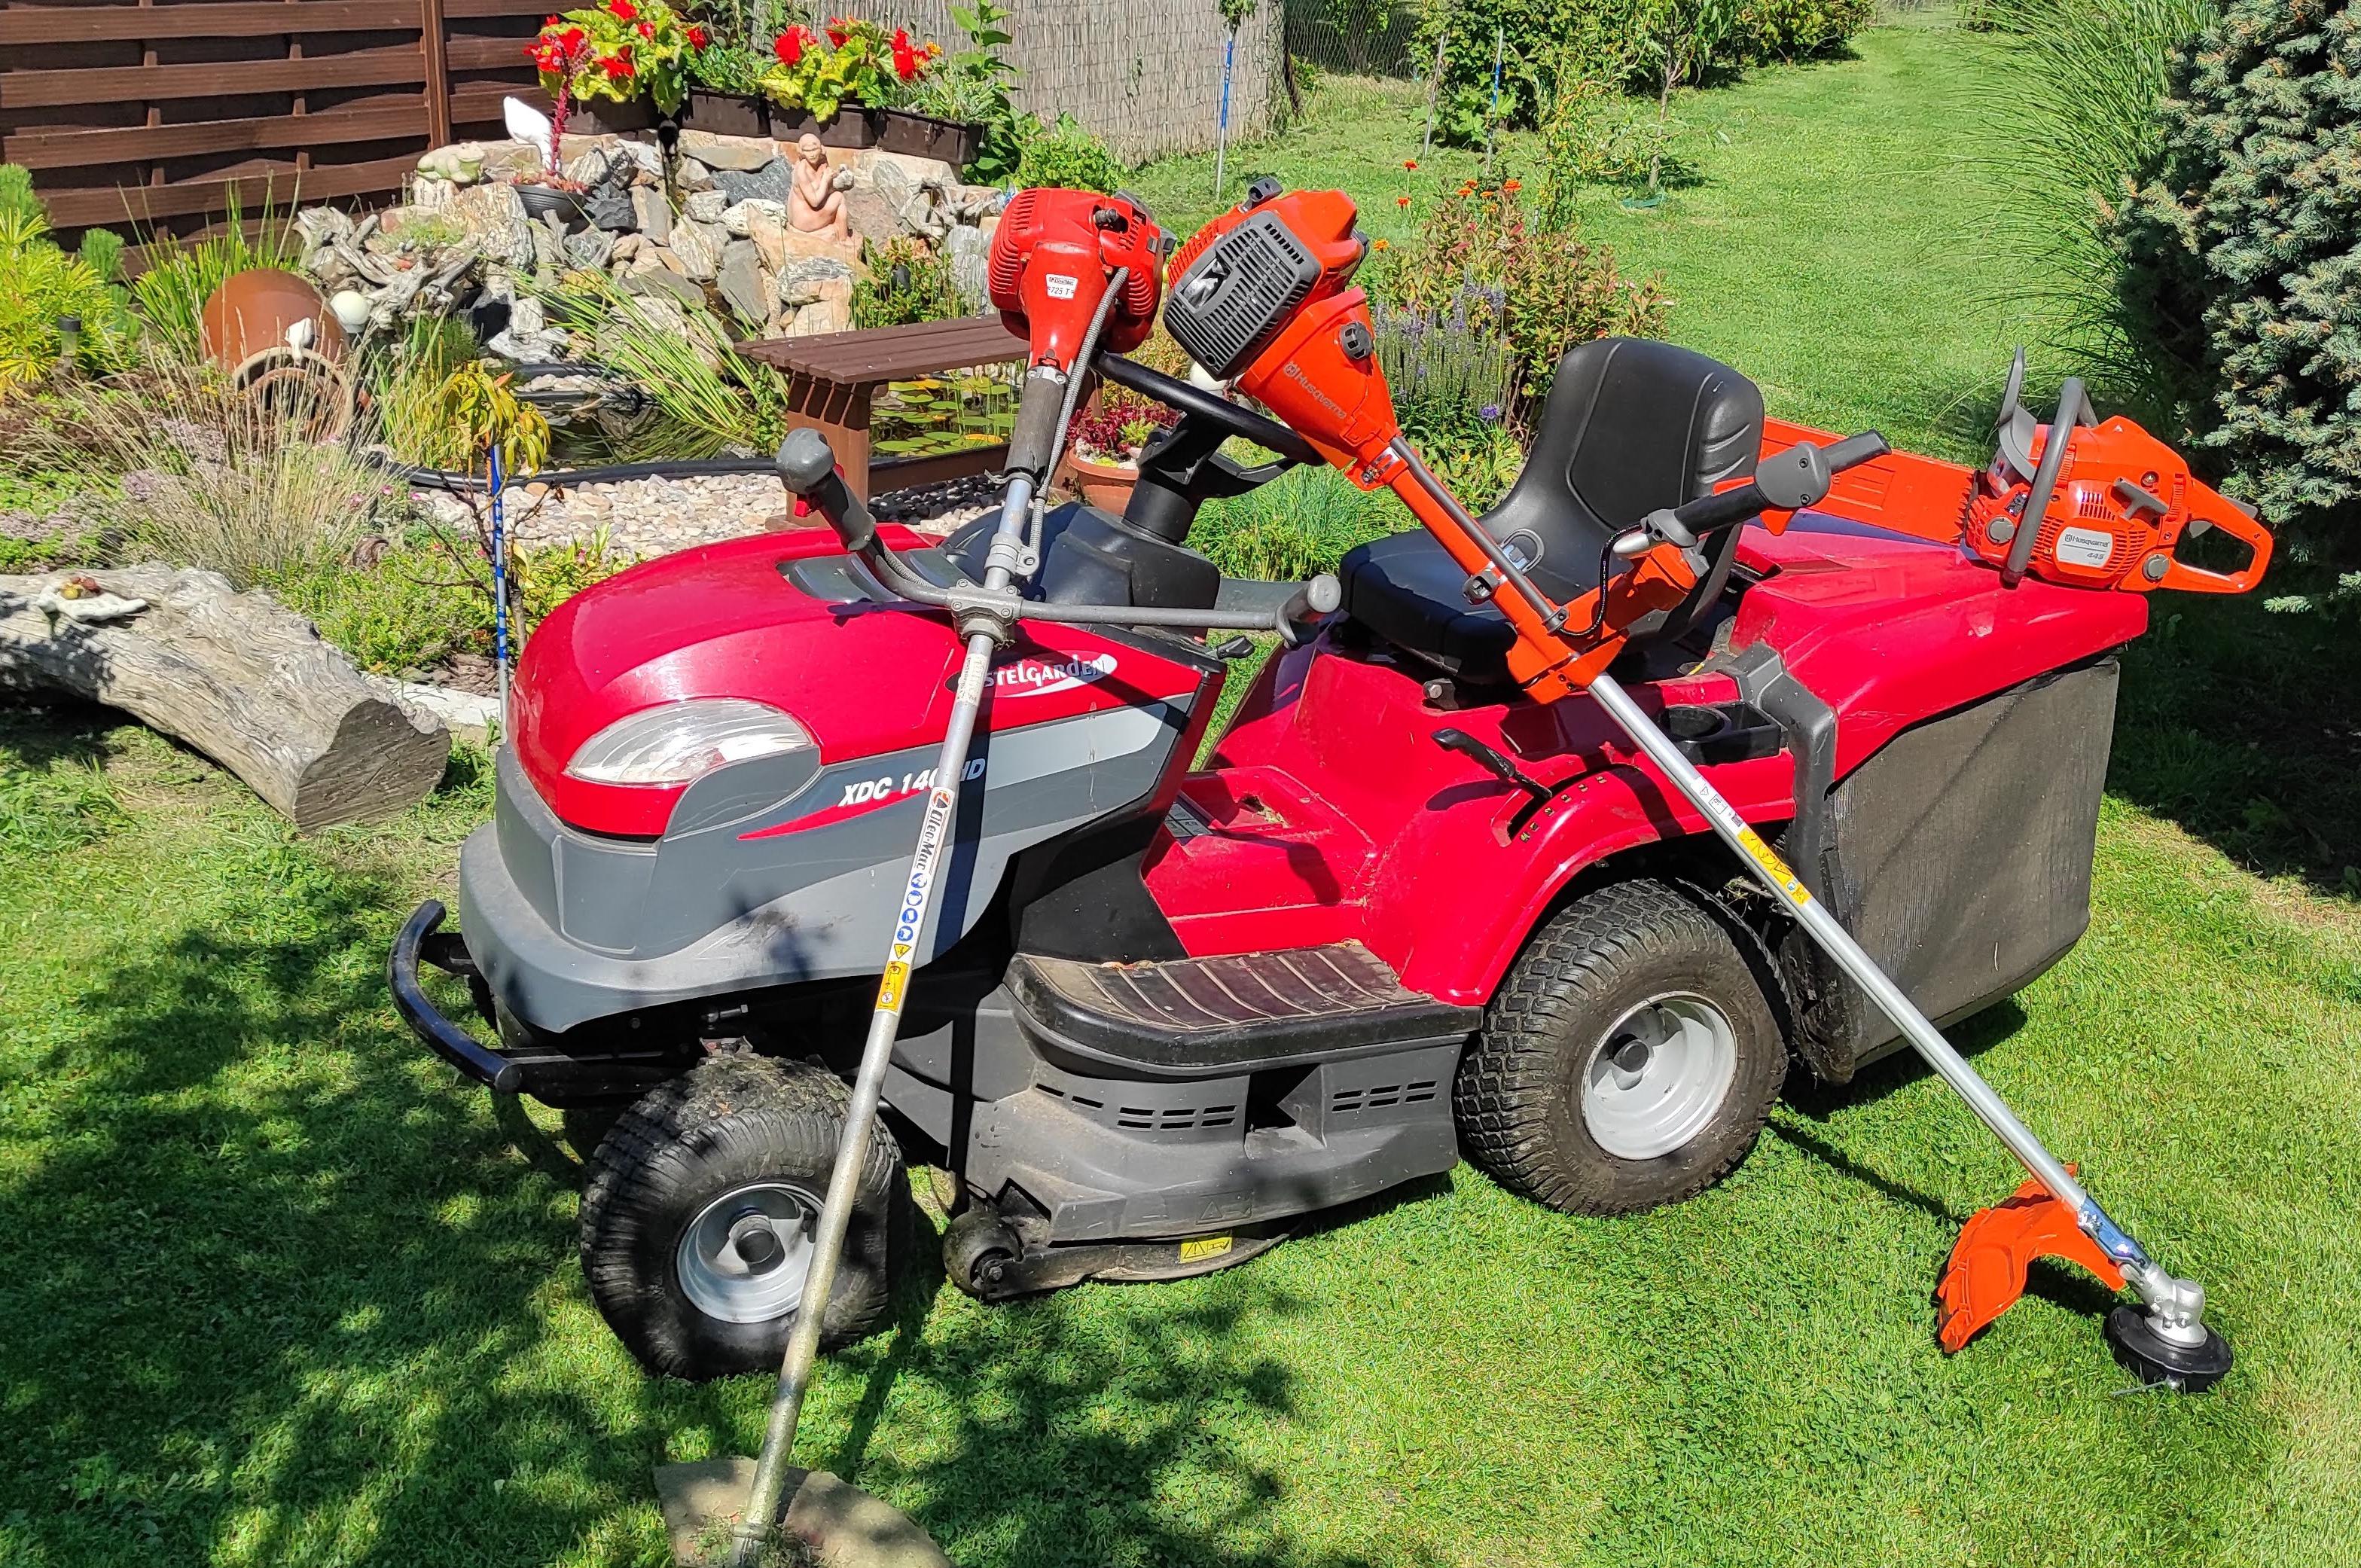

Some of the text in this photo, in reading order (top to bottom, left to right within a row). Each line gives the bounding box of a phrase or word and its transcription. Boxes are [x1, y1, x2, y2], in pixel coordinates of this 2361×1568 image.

[1295, 371, 1347, 419] Husqvarna
[2072, 535, 2109, 548] Husqvarna
[837, 776, 892, 807] XDC
[917, 809, 943, 871] Oleo-Mac
